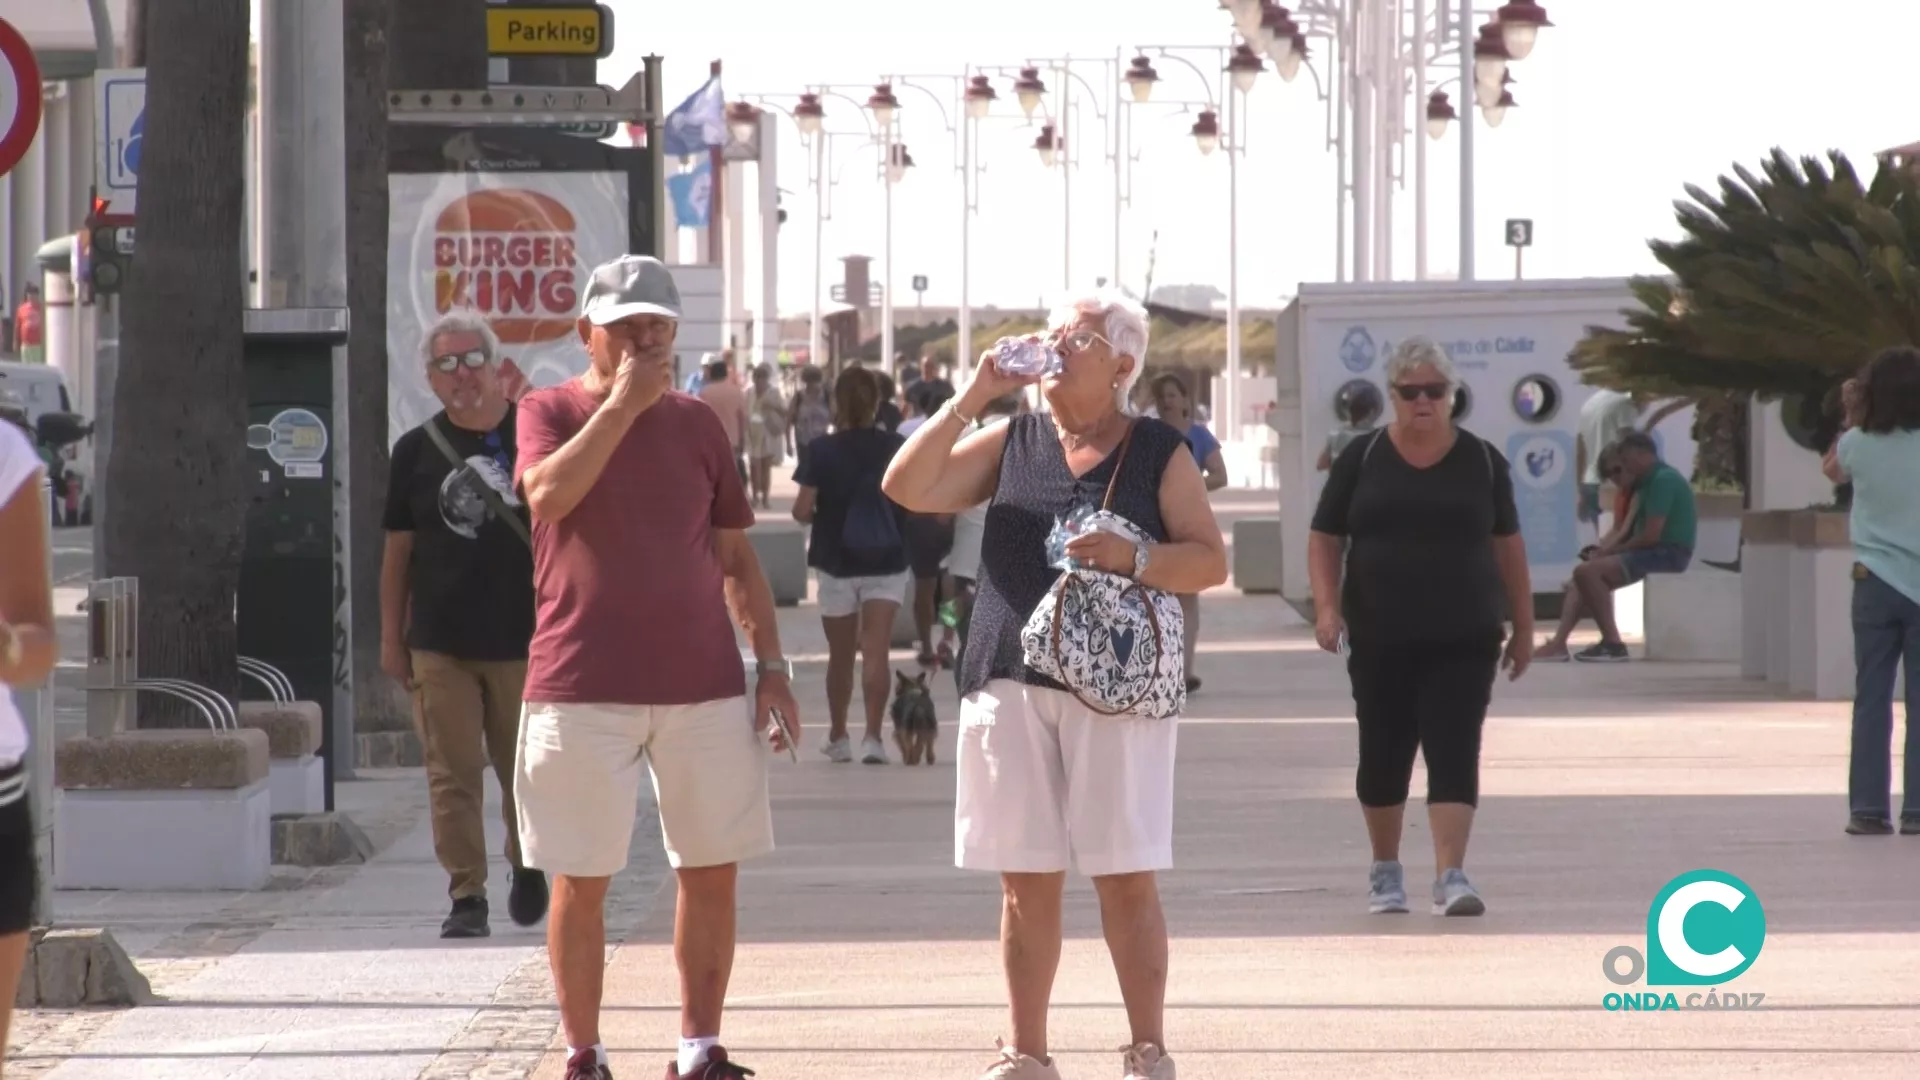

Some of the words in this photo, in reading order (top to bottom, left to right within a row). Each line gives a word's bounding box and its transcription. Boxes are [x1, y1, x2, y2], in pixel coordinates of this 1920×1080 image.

[508, 20, 596, 45] Parking
[1512, 222, 1526, 243] 3
[435, 236, 577, 267] BURGER
[434, 269, 577, 315] KING
